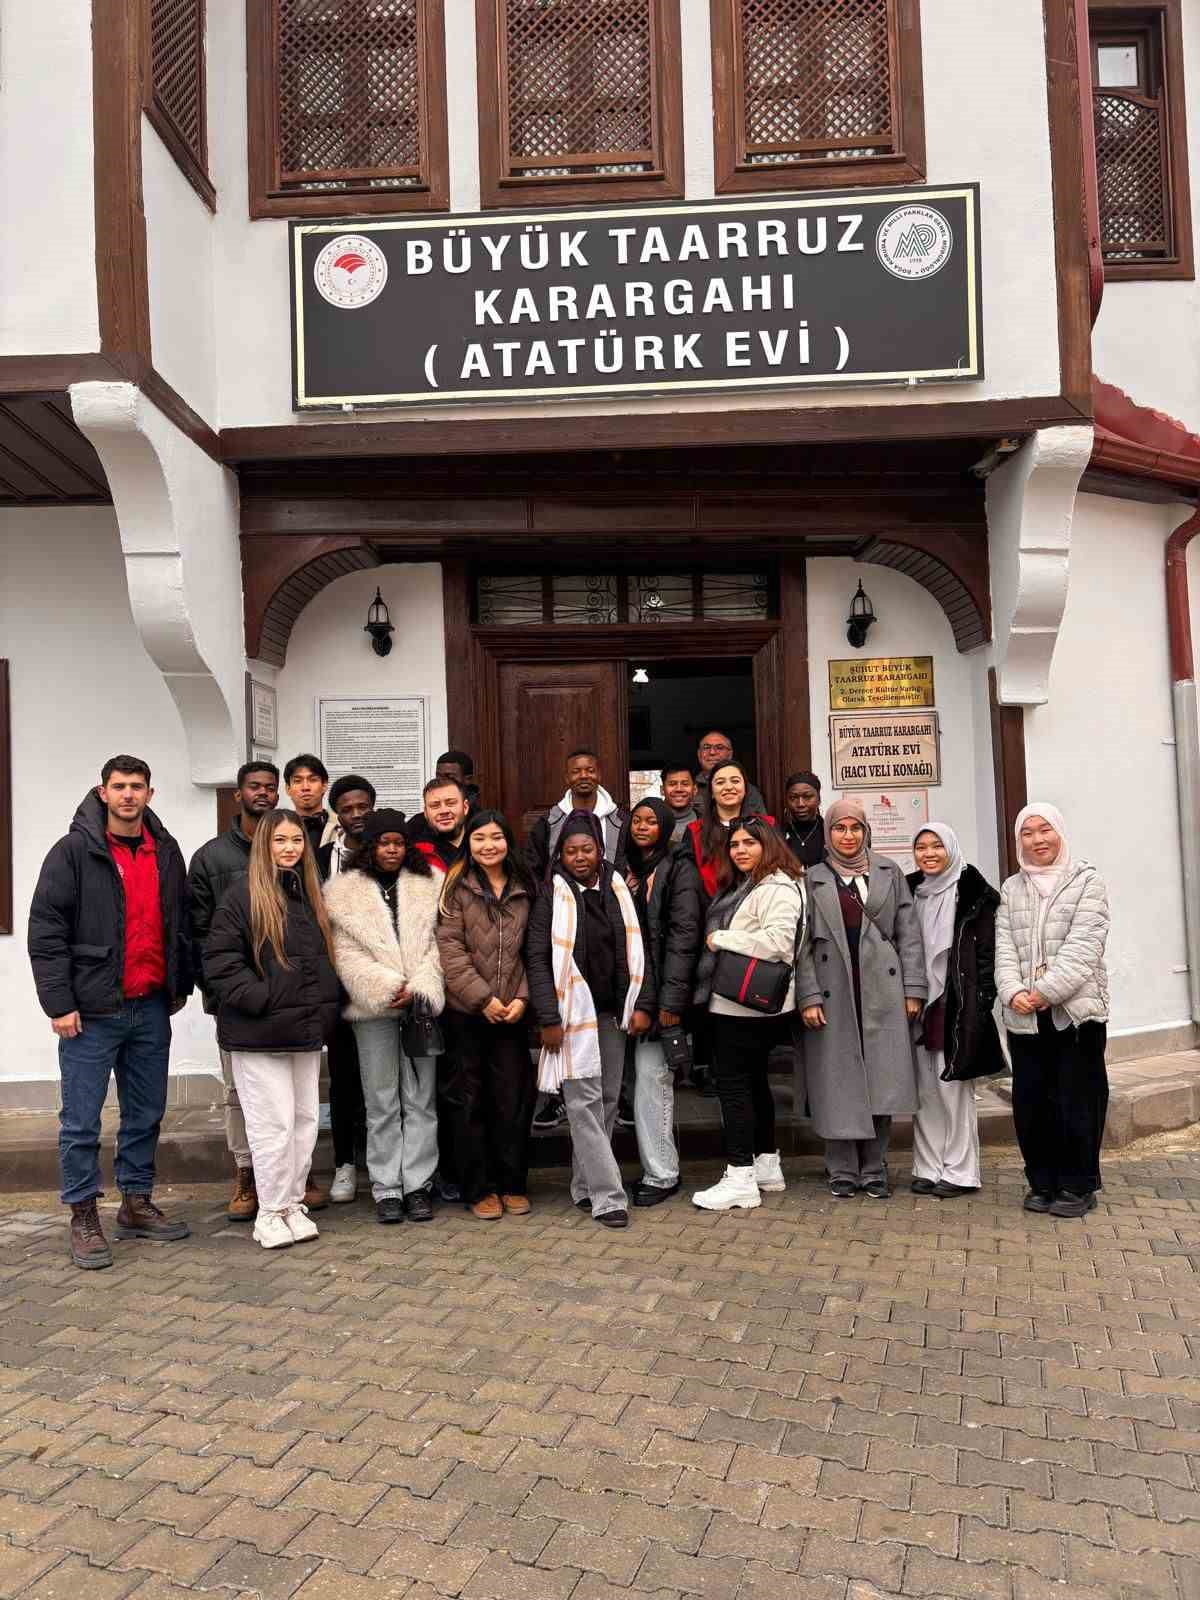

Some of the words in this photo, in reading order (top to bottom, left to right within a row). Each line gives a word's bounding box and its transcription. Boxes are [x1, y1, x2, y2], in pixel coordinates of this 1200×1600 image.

[406, 224, 589, 275] BÜYÜK
[608, 214, 865, 264] TAARRUZ
[474, 273, 794, 325] KARARGAHI
[460, 329, 705, 379] ATATÜRK
[726, 320, 810, 367] EVİ
[834, 674, 875, 684] TAARRUZ
[877, 672, 928, 682] KARARGAHI
[839, 724, 861, 738] BÜYÜK
[862, 726, 892, 738] TAARRUZ
[893, 724, 932, 736] KARARGAHI
[851, 742, 900, 757] ATATÜRK
[902, 740, 921, 755] EVİ
[841, 765, 867, 781] (HACI
[868, 761, 892, 777] VELİ
[893, 760, 933, 778] KONAĞI)
